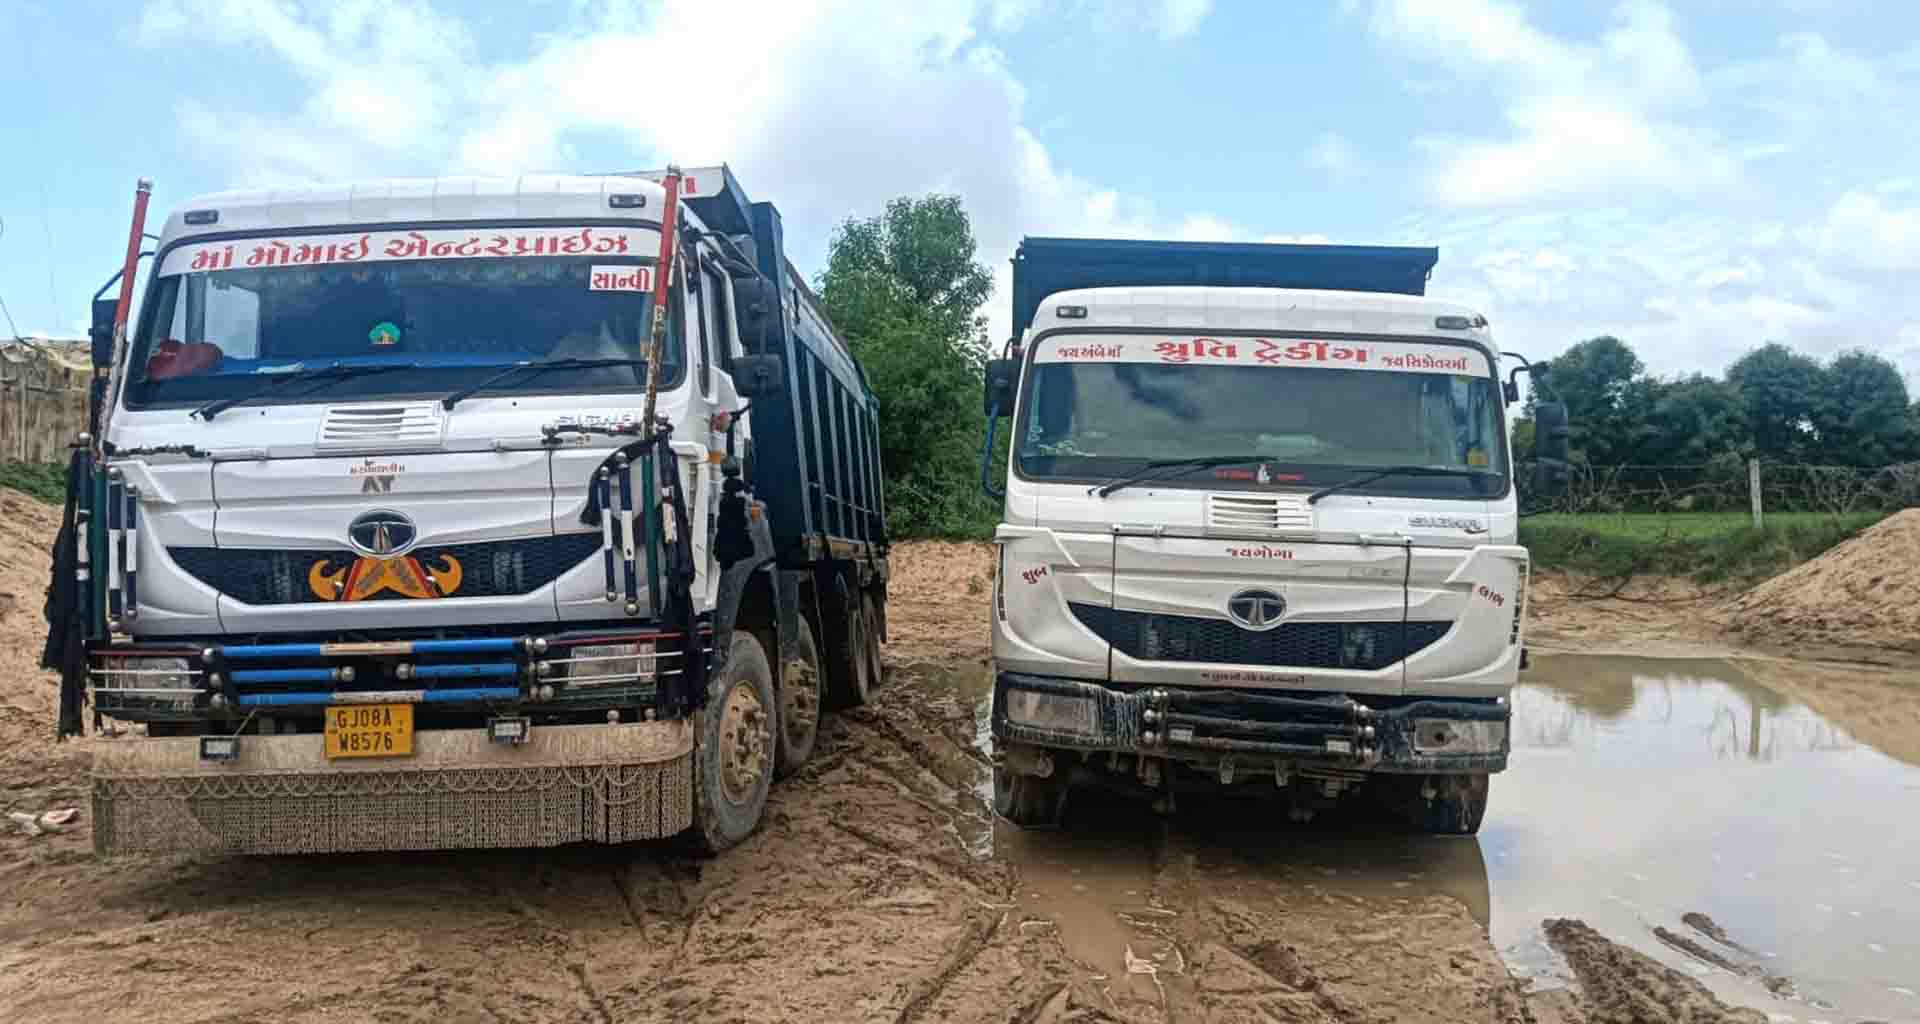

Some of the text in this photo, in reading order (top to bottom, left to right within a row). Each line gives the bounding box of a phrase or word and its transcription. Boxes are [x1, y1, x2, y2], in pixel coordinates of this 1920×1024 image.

[1152, 338, 1237, 363] શ્રુતિ
[336, 707, 392, 729] GJ08A
[338, 731, 393, 751] W8576
